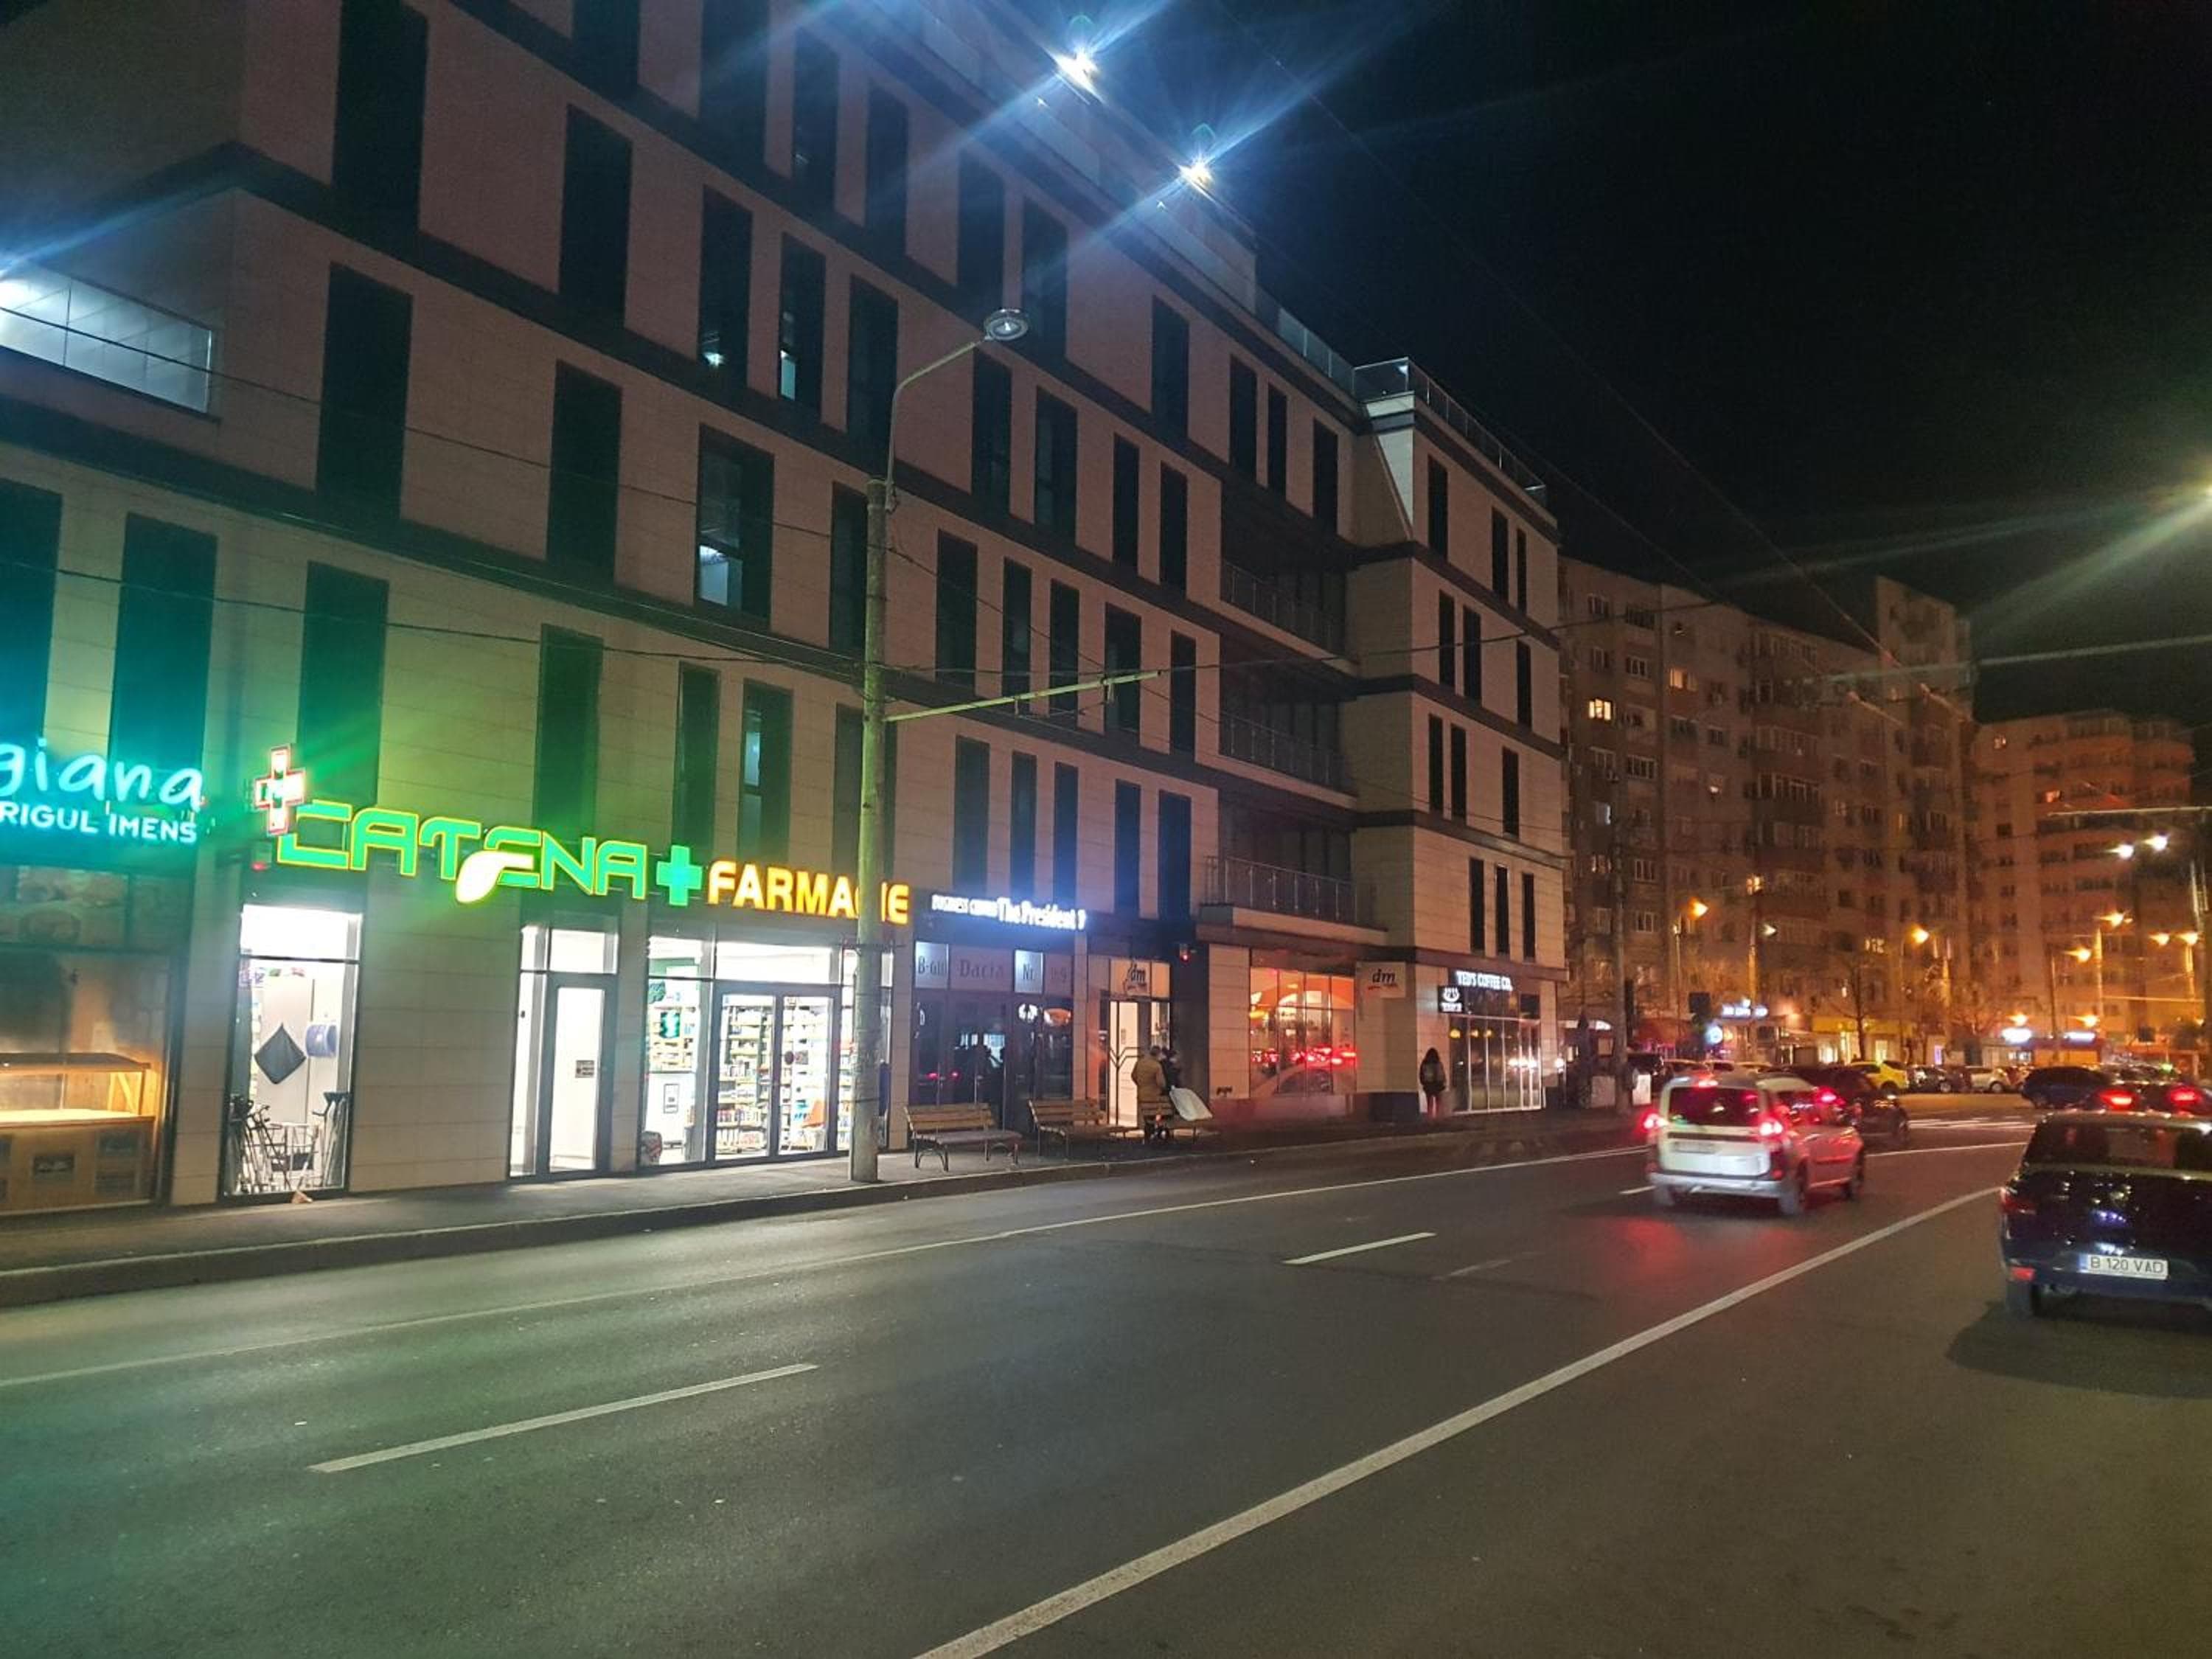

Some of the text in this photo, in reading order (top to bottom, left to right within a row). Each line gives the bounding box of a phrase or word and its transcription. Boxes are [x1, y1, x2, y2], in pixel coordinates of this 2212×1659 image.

[108, 813, 198, 844] IMENS
[276, 799, 648, 902] CATENA
[707, 860, 910, 925] FARMAIE
[1130, 963, 1146, 984] dm
[1372, 968, 1396, 984] dm
[2090, 1256, 2164, 1273] B 120 VAD
